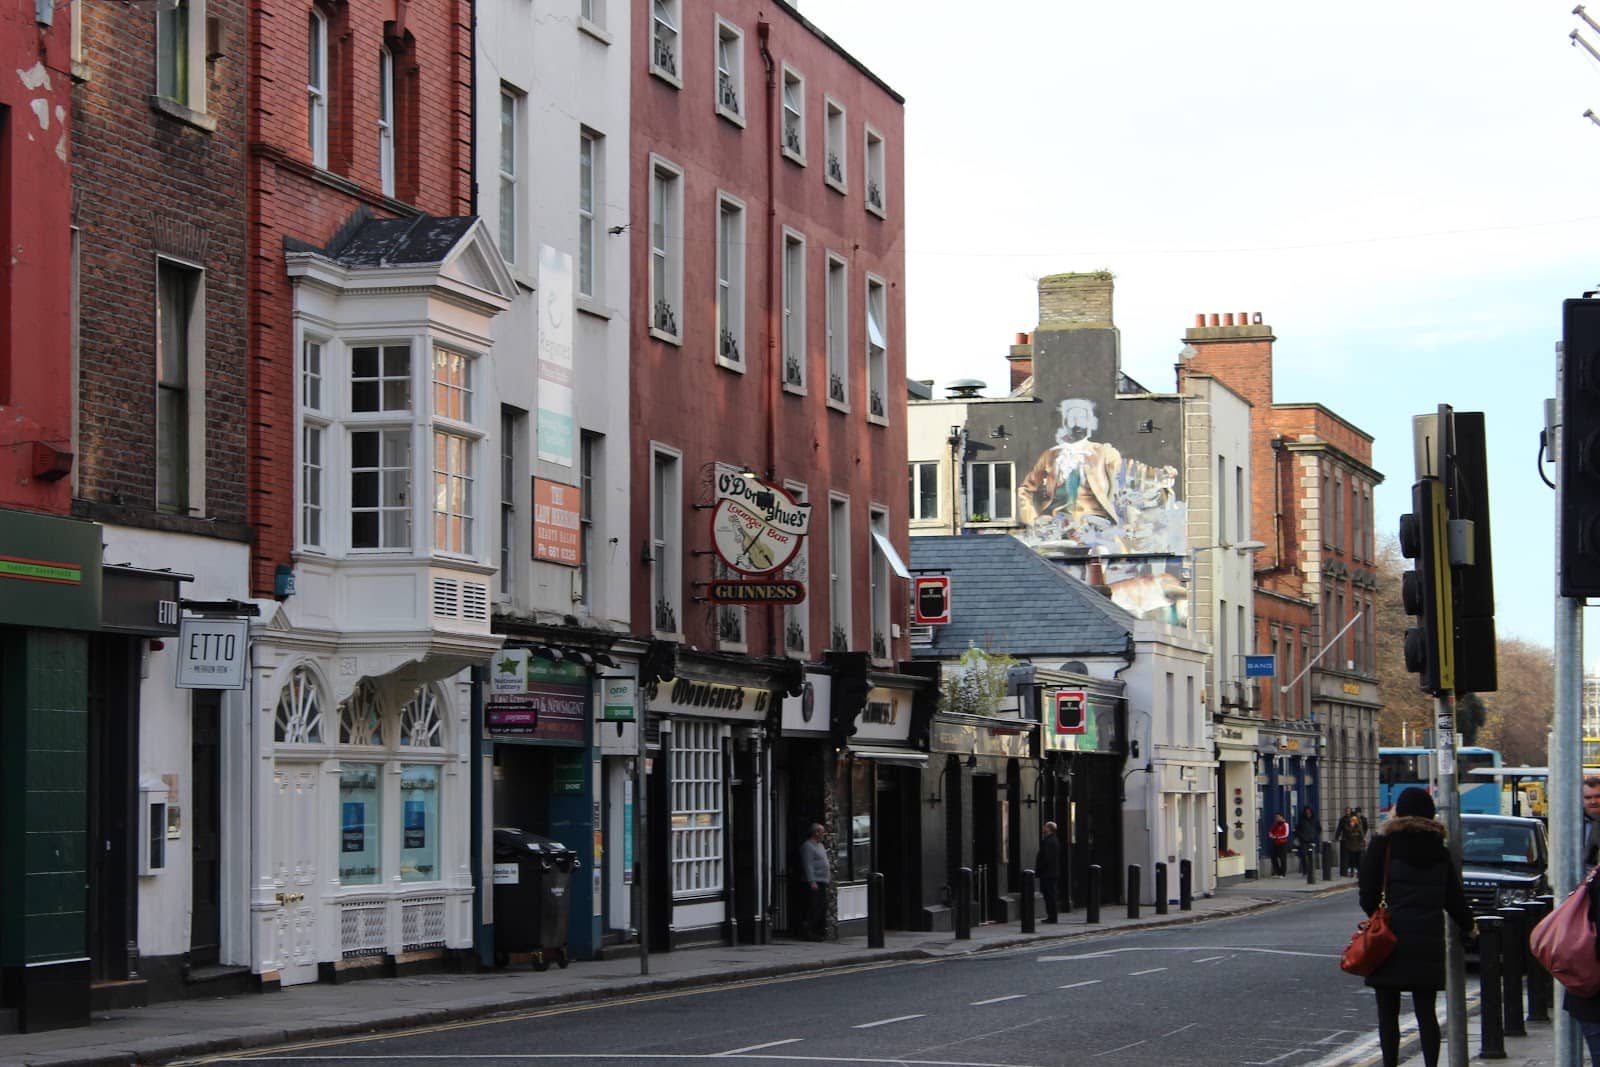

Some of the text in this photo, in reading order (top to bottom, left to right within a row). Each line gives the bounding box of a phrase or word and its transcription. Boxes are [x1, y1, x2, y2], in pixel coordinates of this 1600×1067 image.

[727, 502, 762, 530] Lounge
[715, 585, 798, 600] GUINNESS
[190, 633, 235, 661] ETTO
